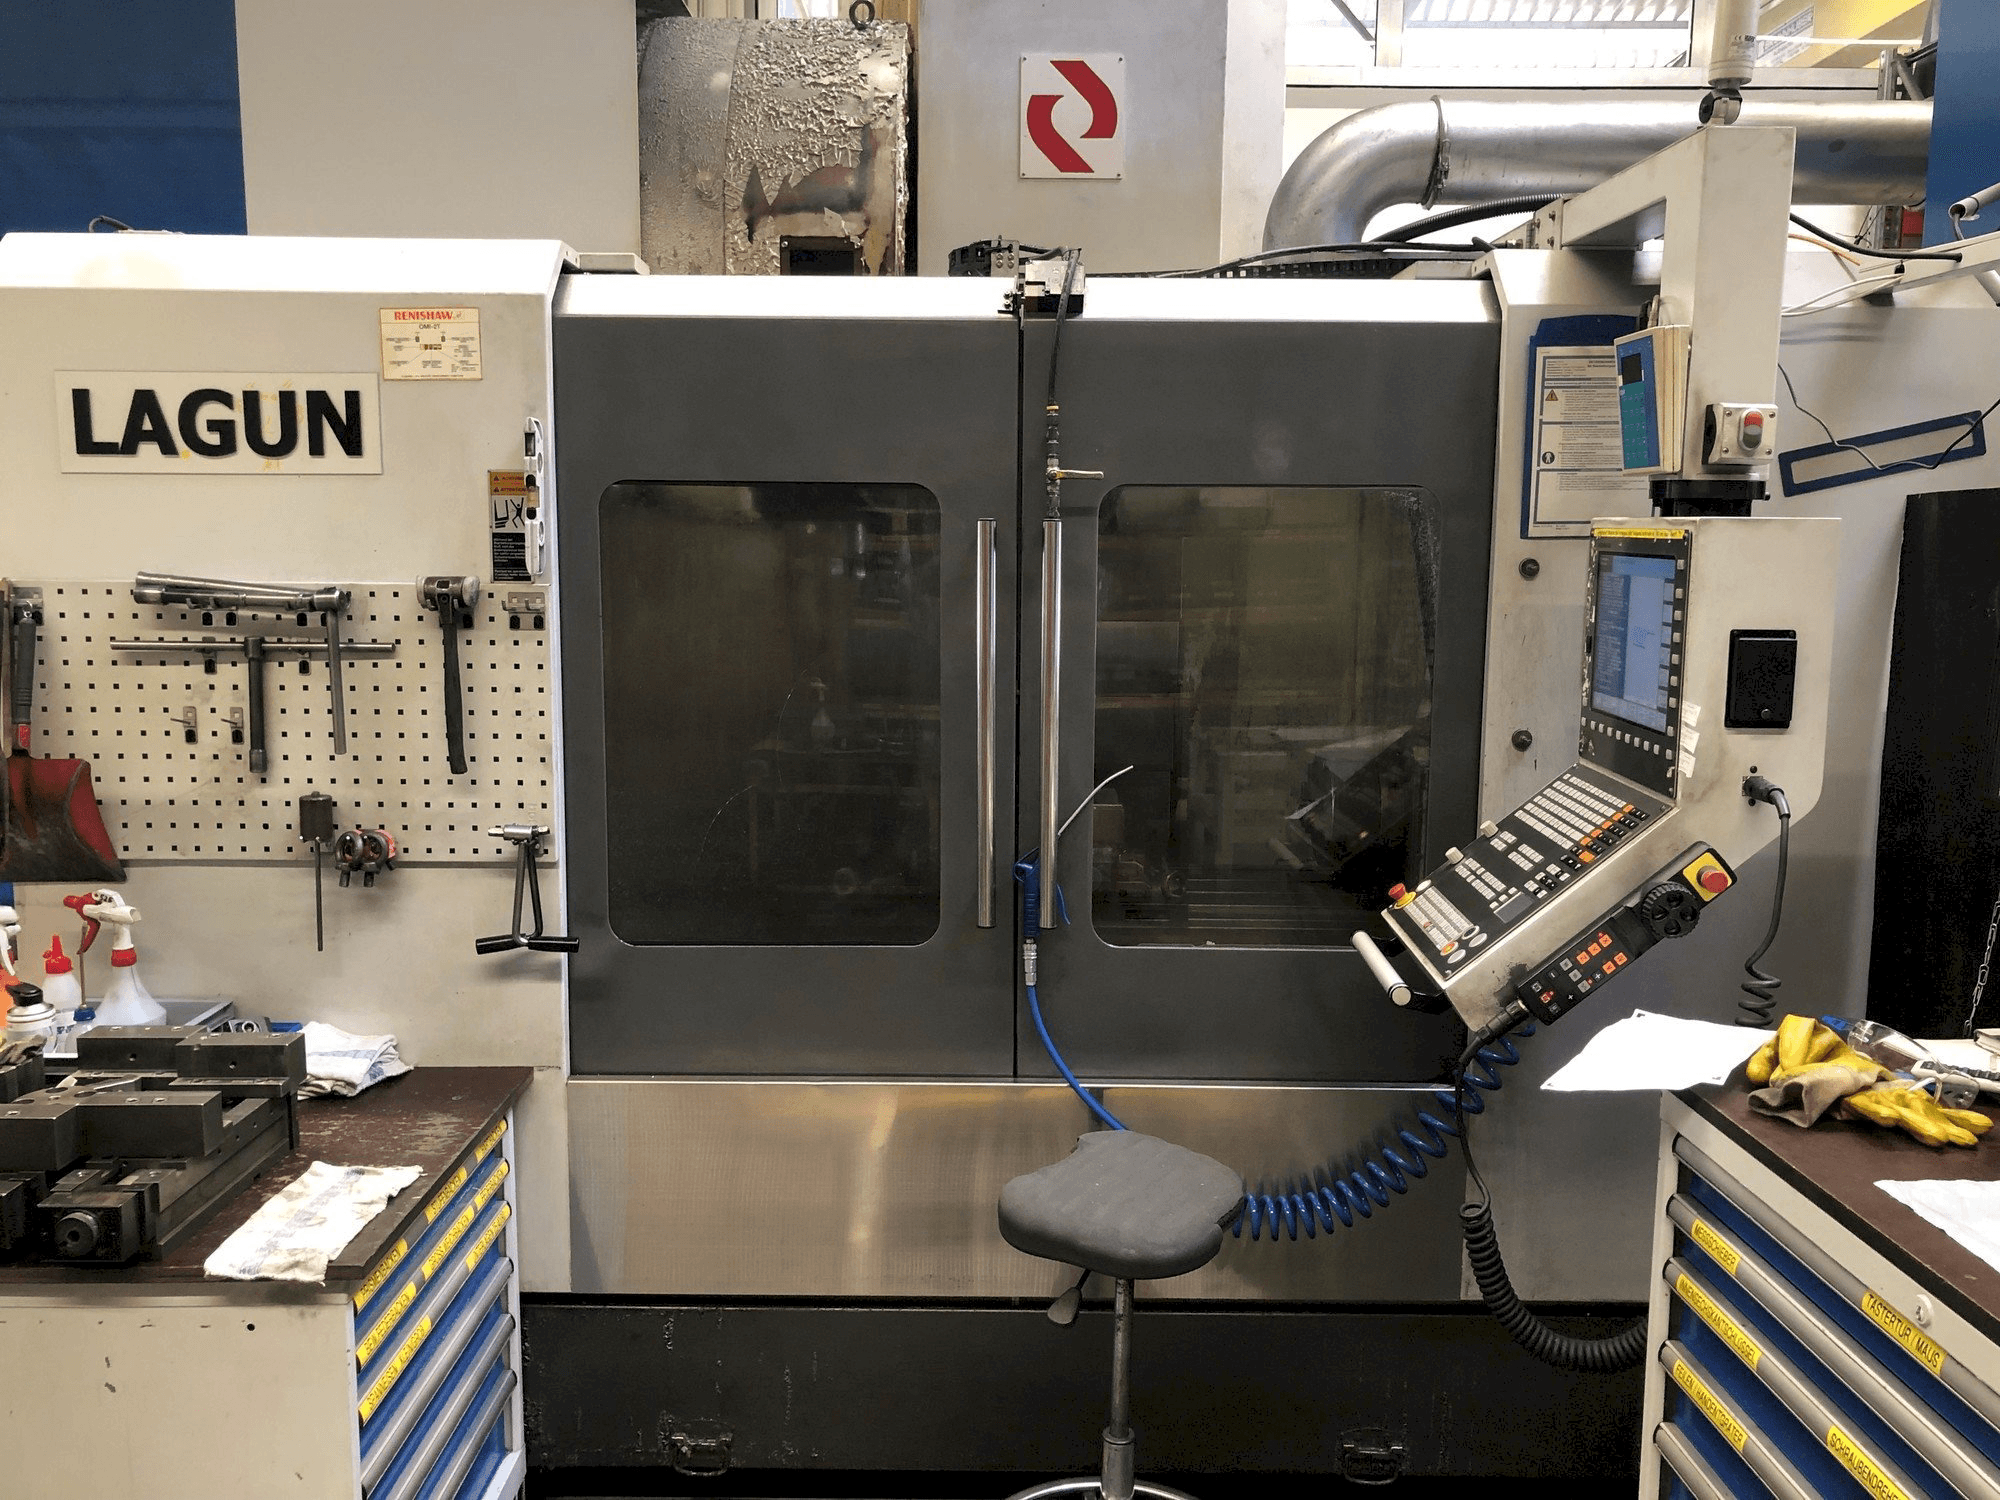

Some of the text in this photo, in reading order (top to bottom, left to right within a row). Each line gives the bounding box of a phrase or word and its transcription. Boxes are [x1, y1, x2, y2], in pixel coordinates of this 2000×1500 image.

[394, 311, 452, 320] RENISHAW
[72, 388, 362, 457] LAGUN
[1694, 1223, 1736, 1267] MESSSCHIEBER
[1866, 1294, 1911, 1342] TASTERTUR
[1915, 1338, 1940, 1367] MAUS
[1675, 1363, 1694, 1389] FEILEN
[1695, 1387, 1743, 1445] HANDENTGRATER
